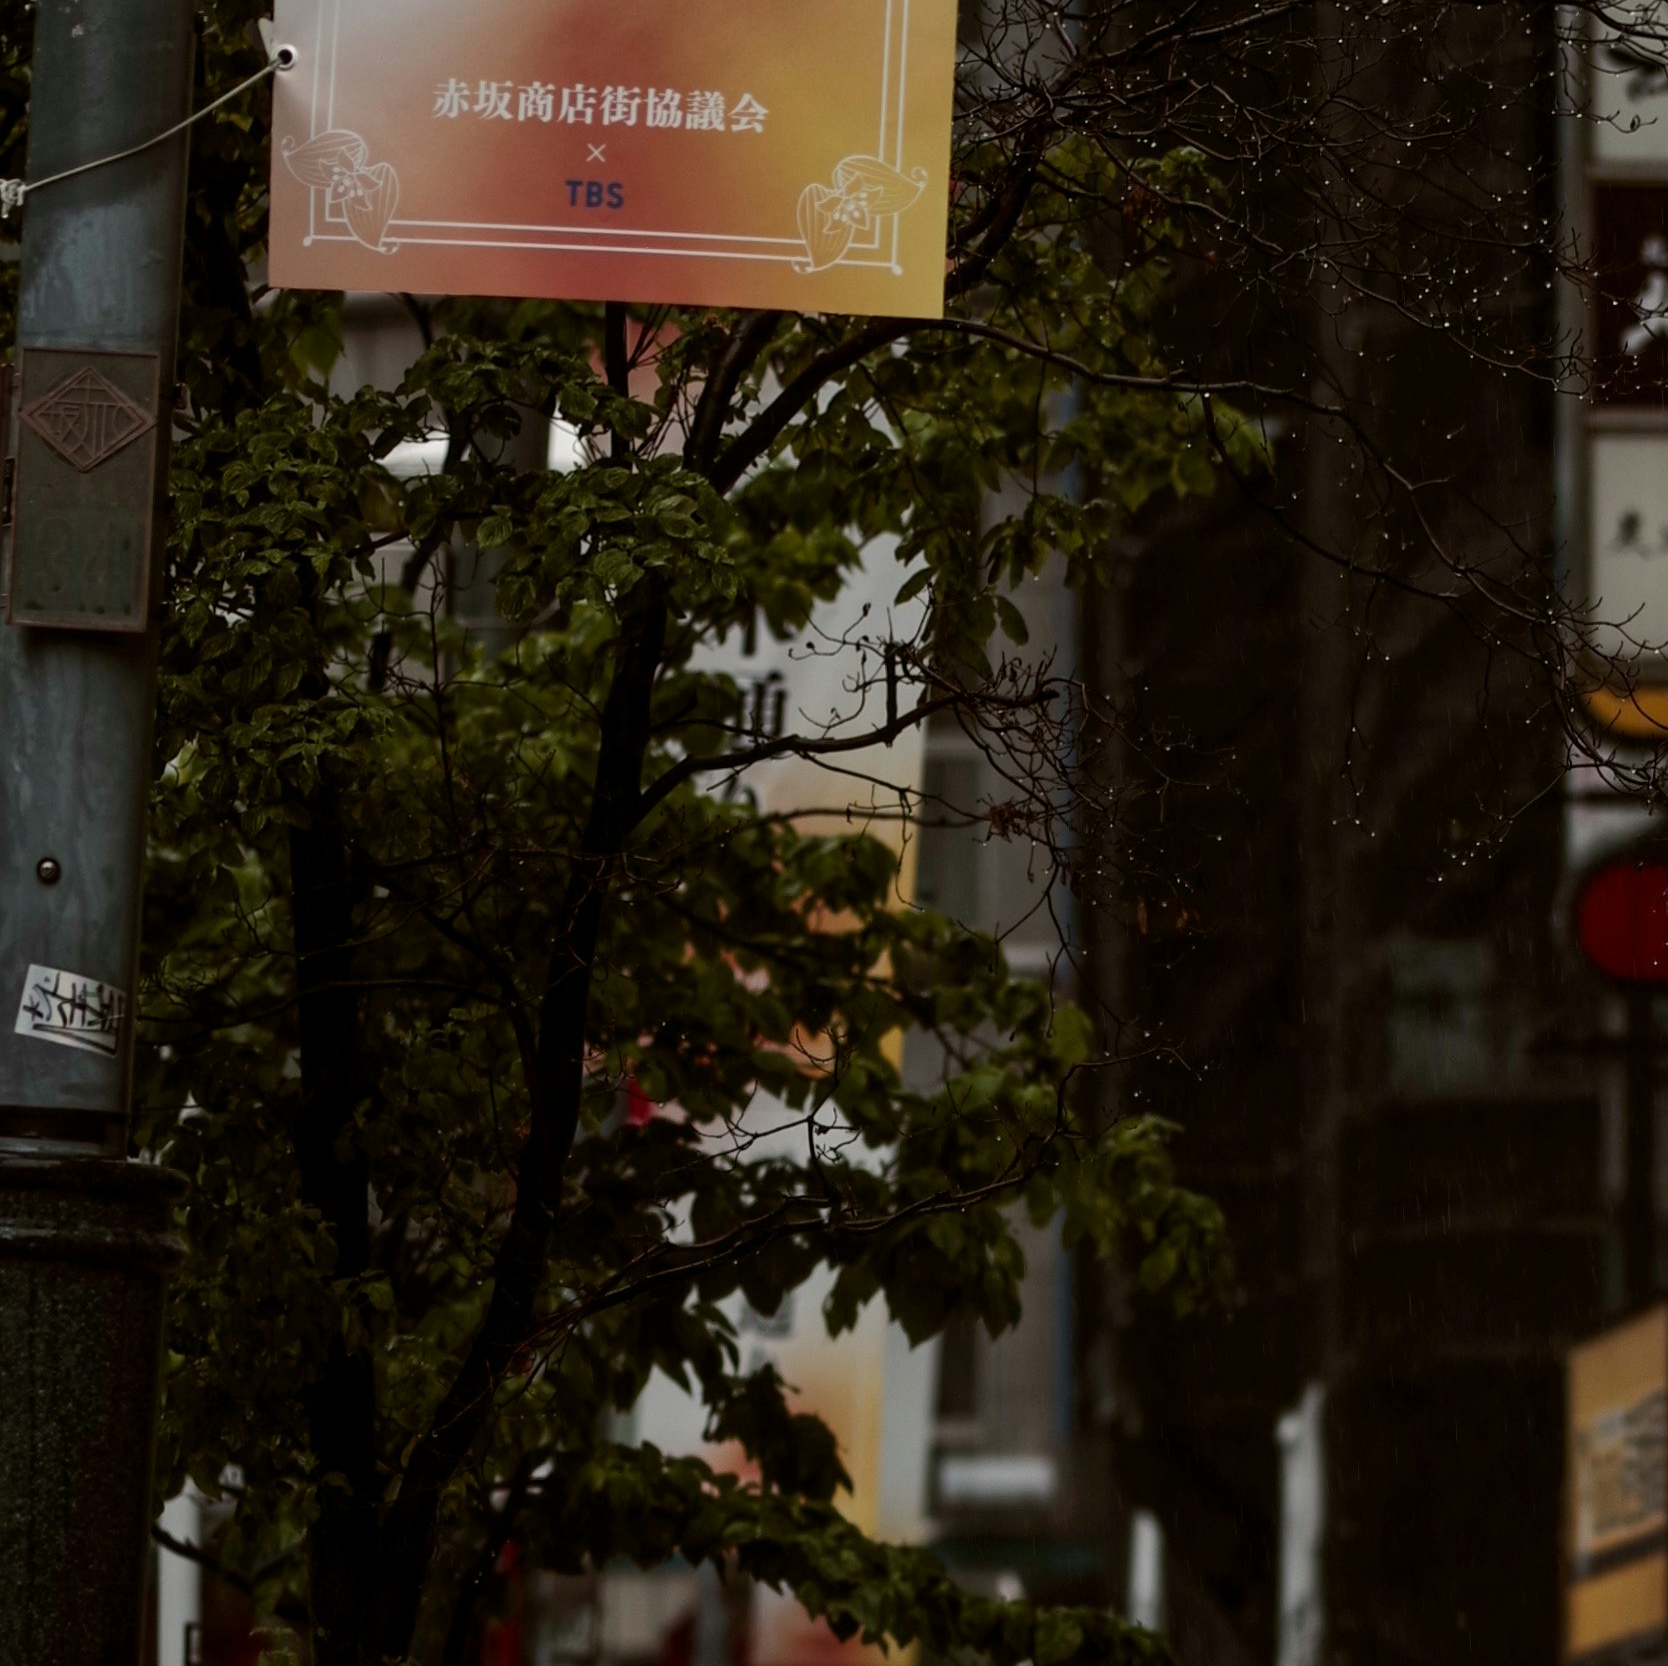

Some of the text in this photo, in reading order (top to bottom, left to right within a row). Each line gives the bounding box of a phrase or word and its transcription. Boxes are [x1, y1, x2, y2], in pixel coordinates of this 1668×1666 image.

[432, 76, 771, 134] 赤坂商店街協議会
[564, 179, 625, 209] TBS
